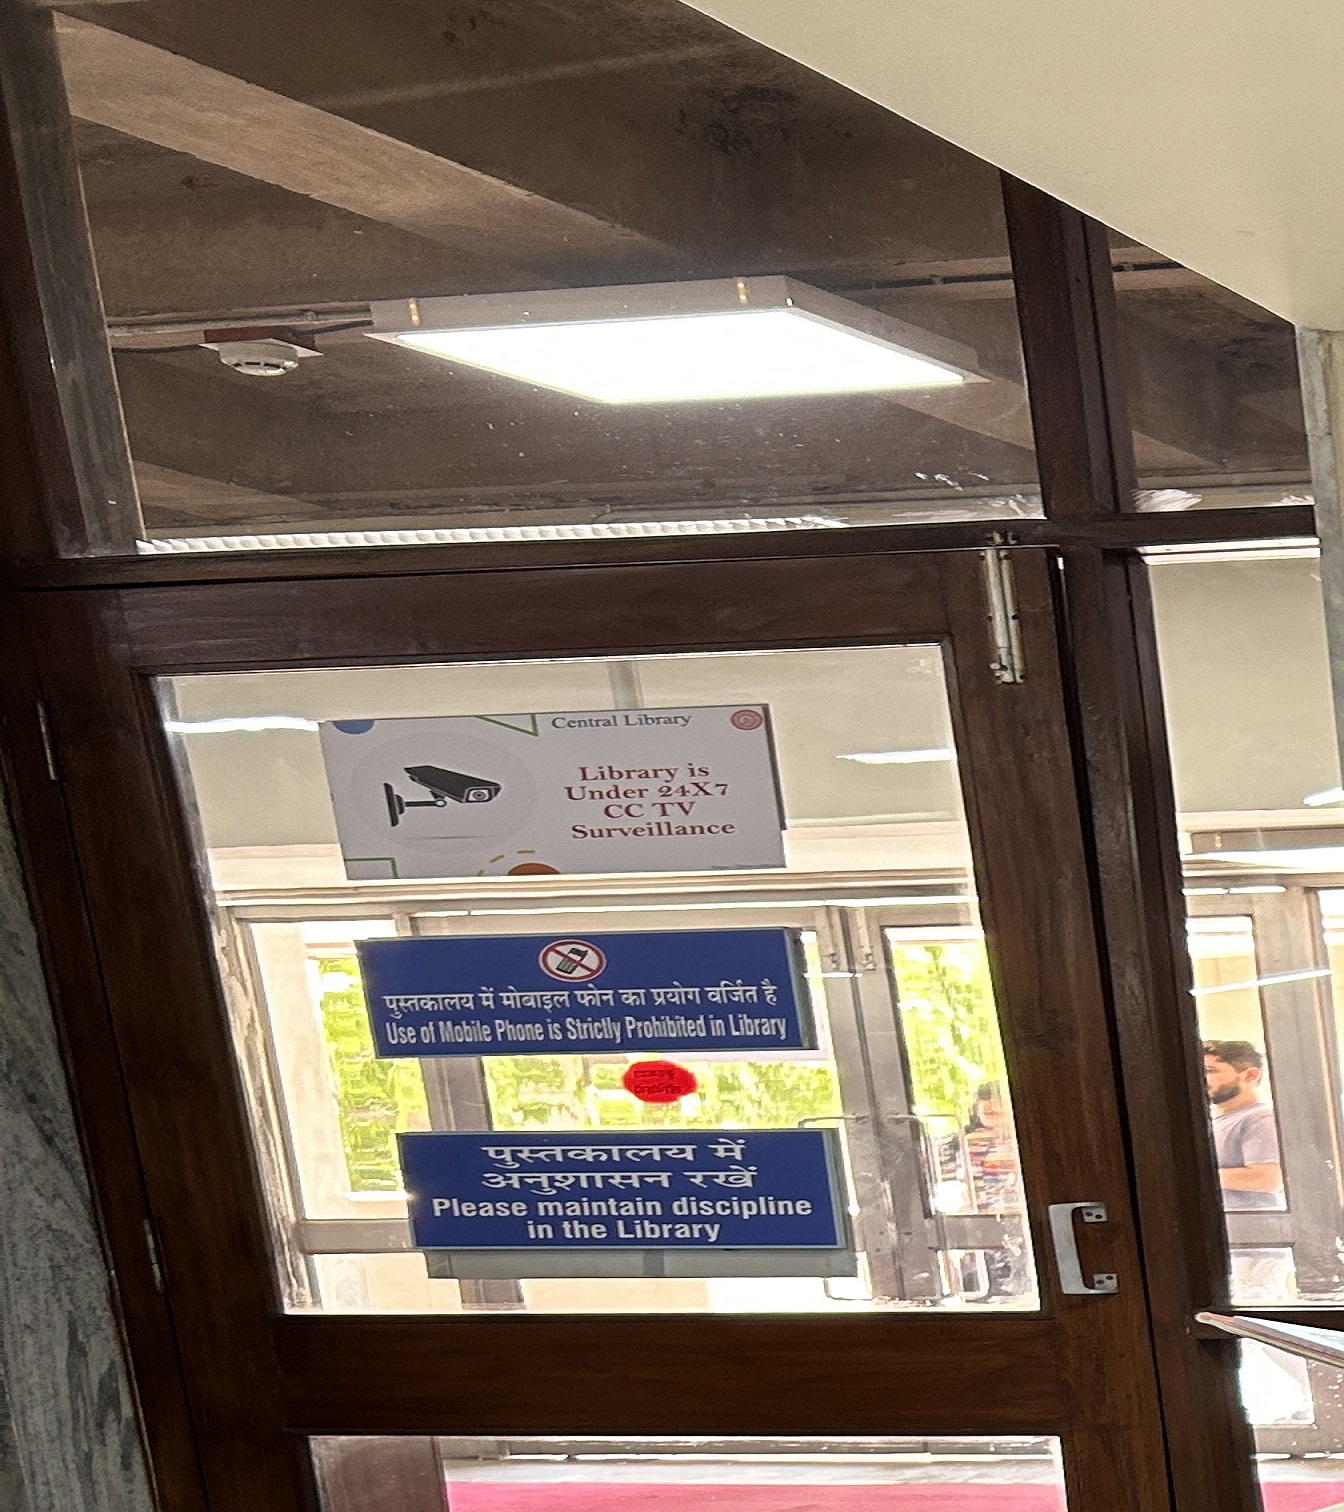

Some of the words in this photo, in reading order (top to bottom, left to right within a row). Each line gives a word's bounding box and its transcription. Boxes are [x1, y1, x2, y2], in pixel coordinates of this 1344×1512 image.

[551, 715, 618, 729] Central
[624, 714, 693, 728] Library
[579, 765, 679, 783] Library
[688, 763, 710, 777] is
[564, 785, 649, 801] Under
[658, 782, 729, 798] 24X7
[603, 803, 644, 819] CC
[652, 802, 696, 817] TV
[571, 822, 736, 839] Surveillance
[381, 993, 475, 1019] पुस्तकालय
[479, 986, 495, 1010] में
[499, 986, 571, 1015] मोबाइल
[574, 983, 615, 1007] फोन
[618, 988, 646, 1006] का
[651, 981, 701, 1006] प्रयोग
[704, 979, 758, 1004] वर्जित
[761, 978, 777, 1006] है
[385, 1022, 417, 1045] Use
[420, 1020, 436, 1044] of
[439, 1020, 492, 1044] Mobile
[494, 1019, 544, 1042] Phone
[547, 1019, 563, 1040] is
[565, 1016, 621, 1044] Strictly
[625, 1014, 706, 1039] Prohibited
[710, 1014, 726, 1037] in
[728, 1013, 786, 1041] Library
[481, 1144, 697, 1168] पुस्तकालय
[707, 1138, 747, 1161] में
[481, 1171, 673, 1195] अनुशासन
[683, 1165, 758, 1190] रखें
[432, 1197, 528, 1218] Please
[537, 1196, 662, 1217] maintain
[672, 1196, 813, 1219] discipline
[527, 1220, 554, 1240] in
[562, 1220, 608, 1240] the
[617, 1219, 721, 1242] Library
